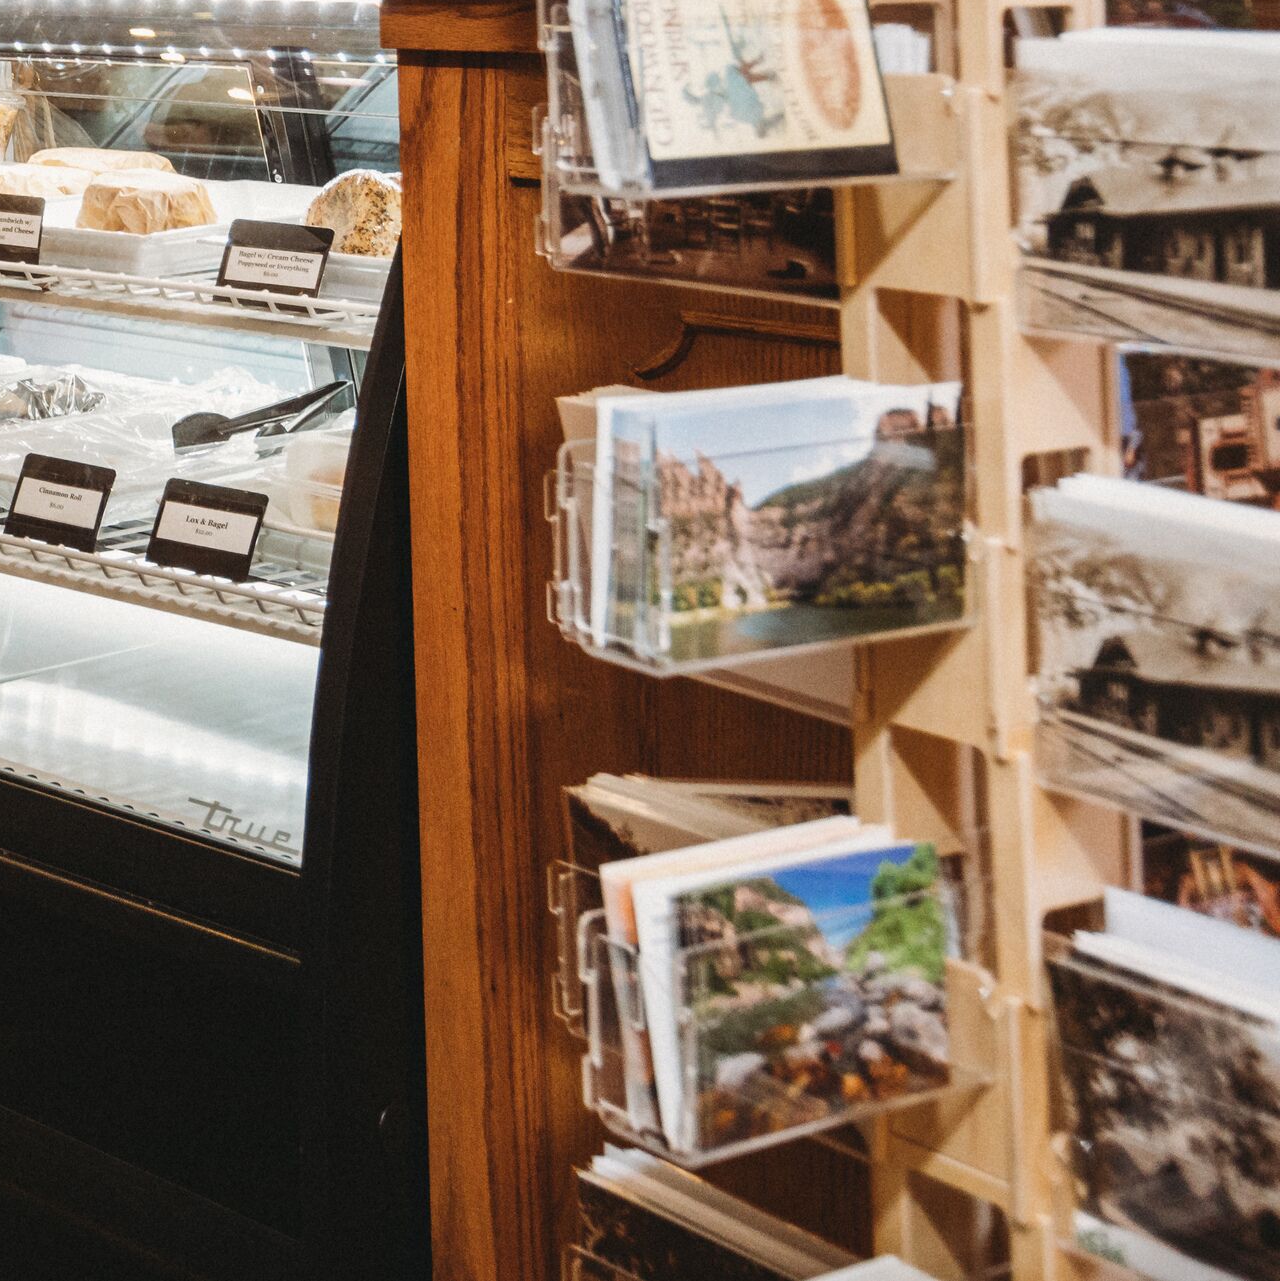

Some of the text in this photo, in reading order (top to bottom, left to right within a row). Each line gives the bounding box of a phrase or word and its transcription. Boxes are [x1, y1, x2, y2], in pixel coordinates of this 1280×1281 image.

[14, 227, 35, 235] Cheese
[239, 250, 314, 264] Bagel w/ Cream Cheese
[237, 260, 268, 269] Poppyseed
[276, 263, 309, 273] Everything
[39, 486, 83, 501] Cinnamon Roll
[185, 515, 199, 524] Lox
[207, 519, 229, 530] Bagel
